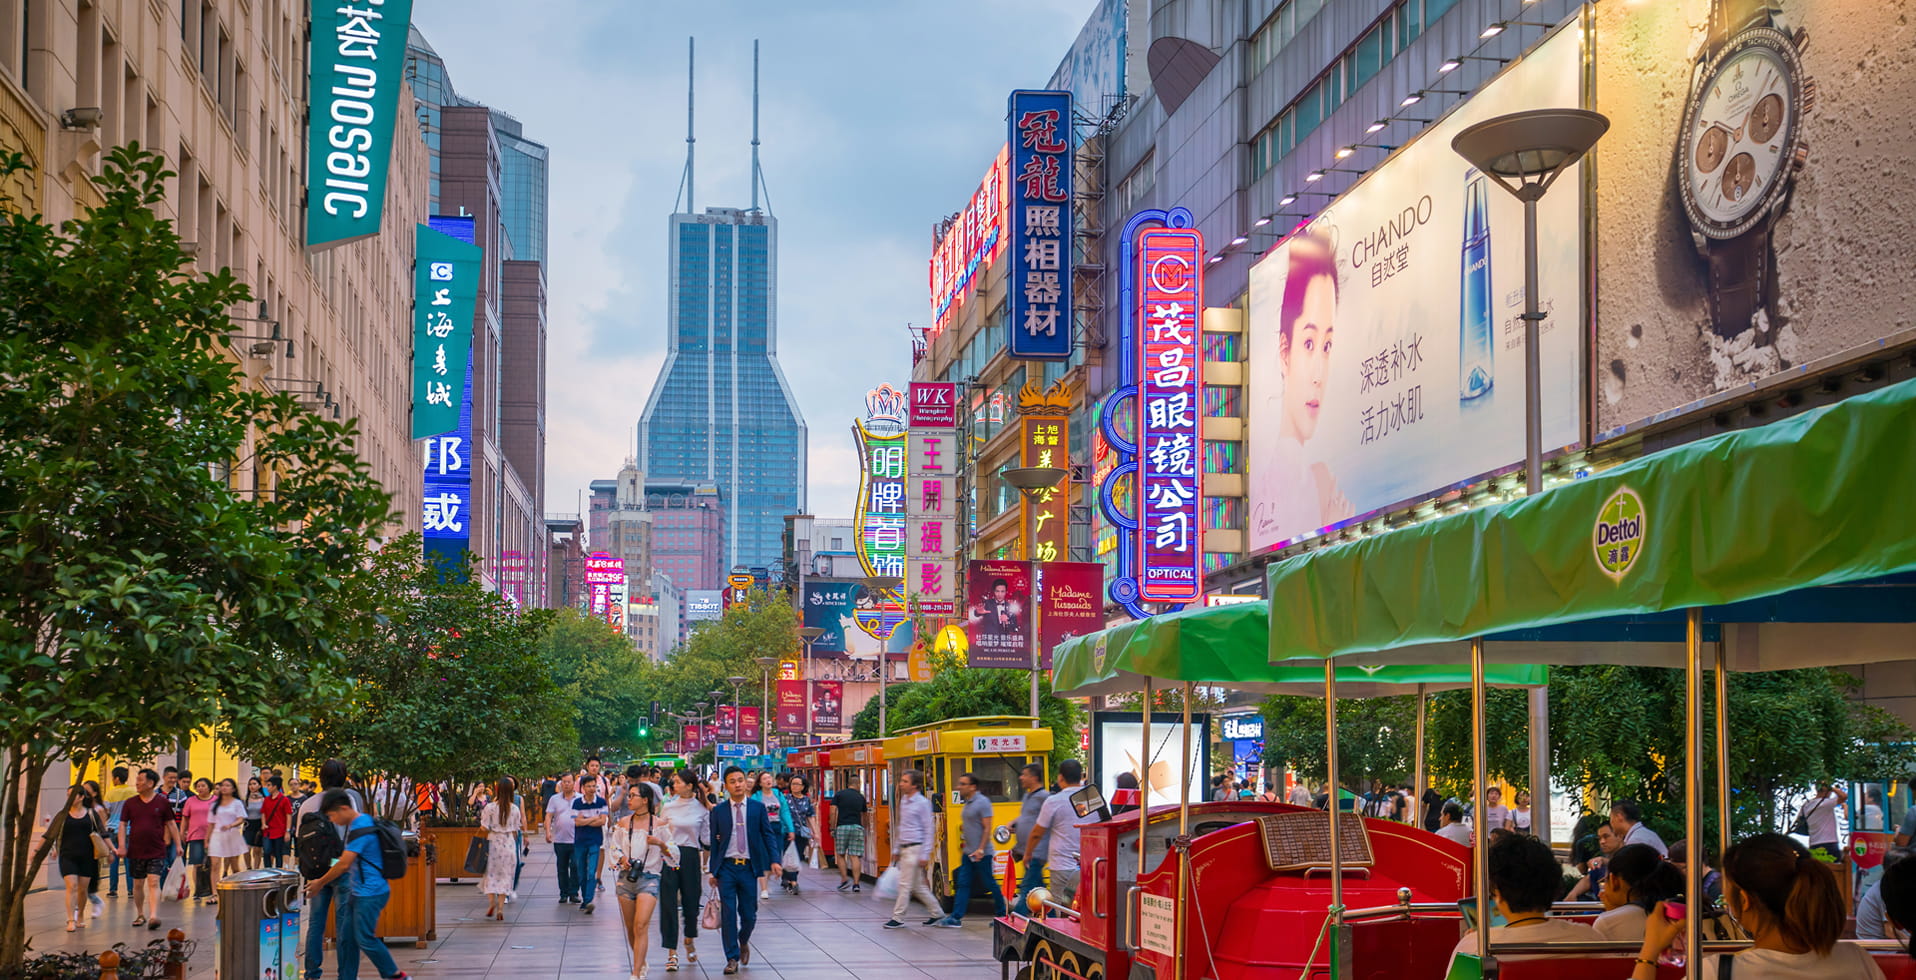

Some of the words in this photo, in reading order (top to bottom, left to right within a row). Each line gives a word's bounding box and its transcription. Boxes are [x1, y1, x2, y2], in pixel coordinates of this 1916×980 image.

[1351, 194, 1433, 270] CHANDO
[1371, 242, 1410, 289] 自然堂
[1360, 331, 1424, 396] 深透补水
[916, 388, 950, 404] WK
[1360, 384, 1424, 446] 活力冰肌
[1148, 301, 1195, 554] 茂昌眼镜公司
[1597, 514, 1640, 545] Dettol
[1147, 567, 1194, 579] OPTICAL
[1050, 584, 1093, 599] Madame
[1050, 598, 1092, 610] Tussauds
[991, 738, 1020, 746] 观光车
[953, 792, 959, 803] 7
